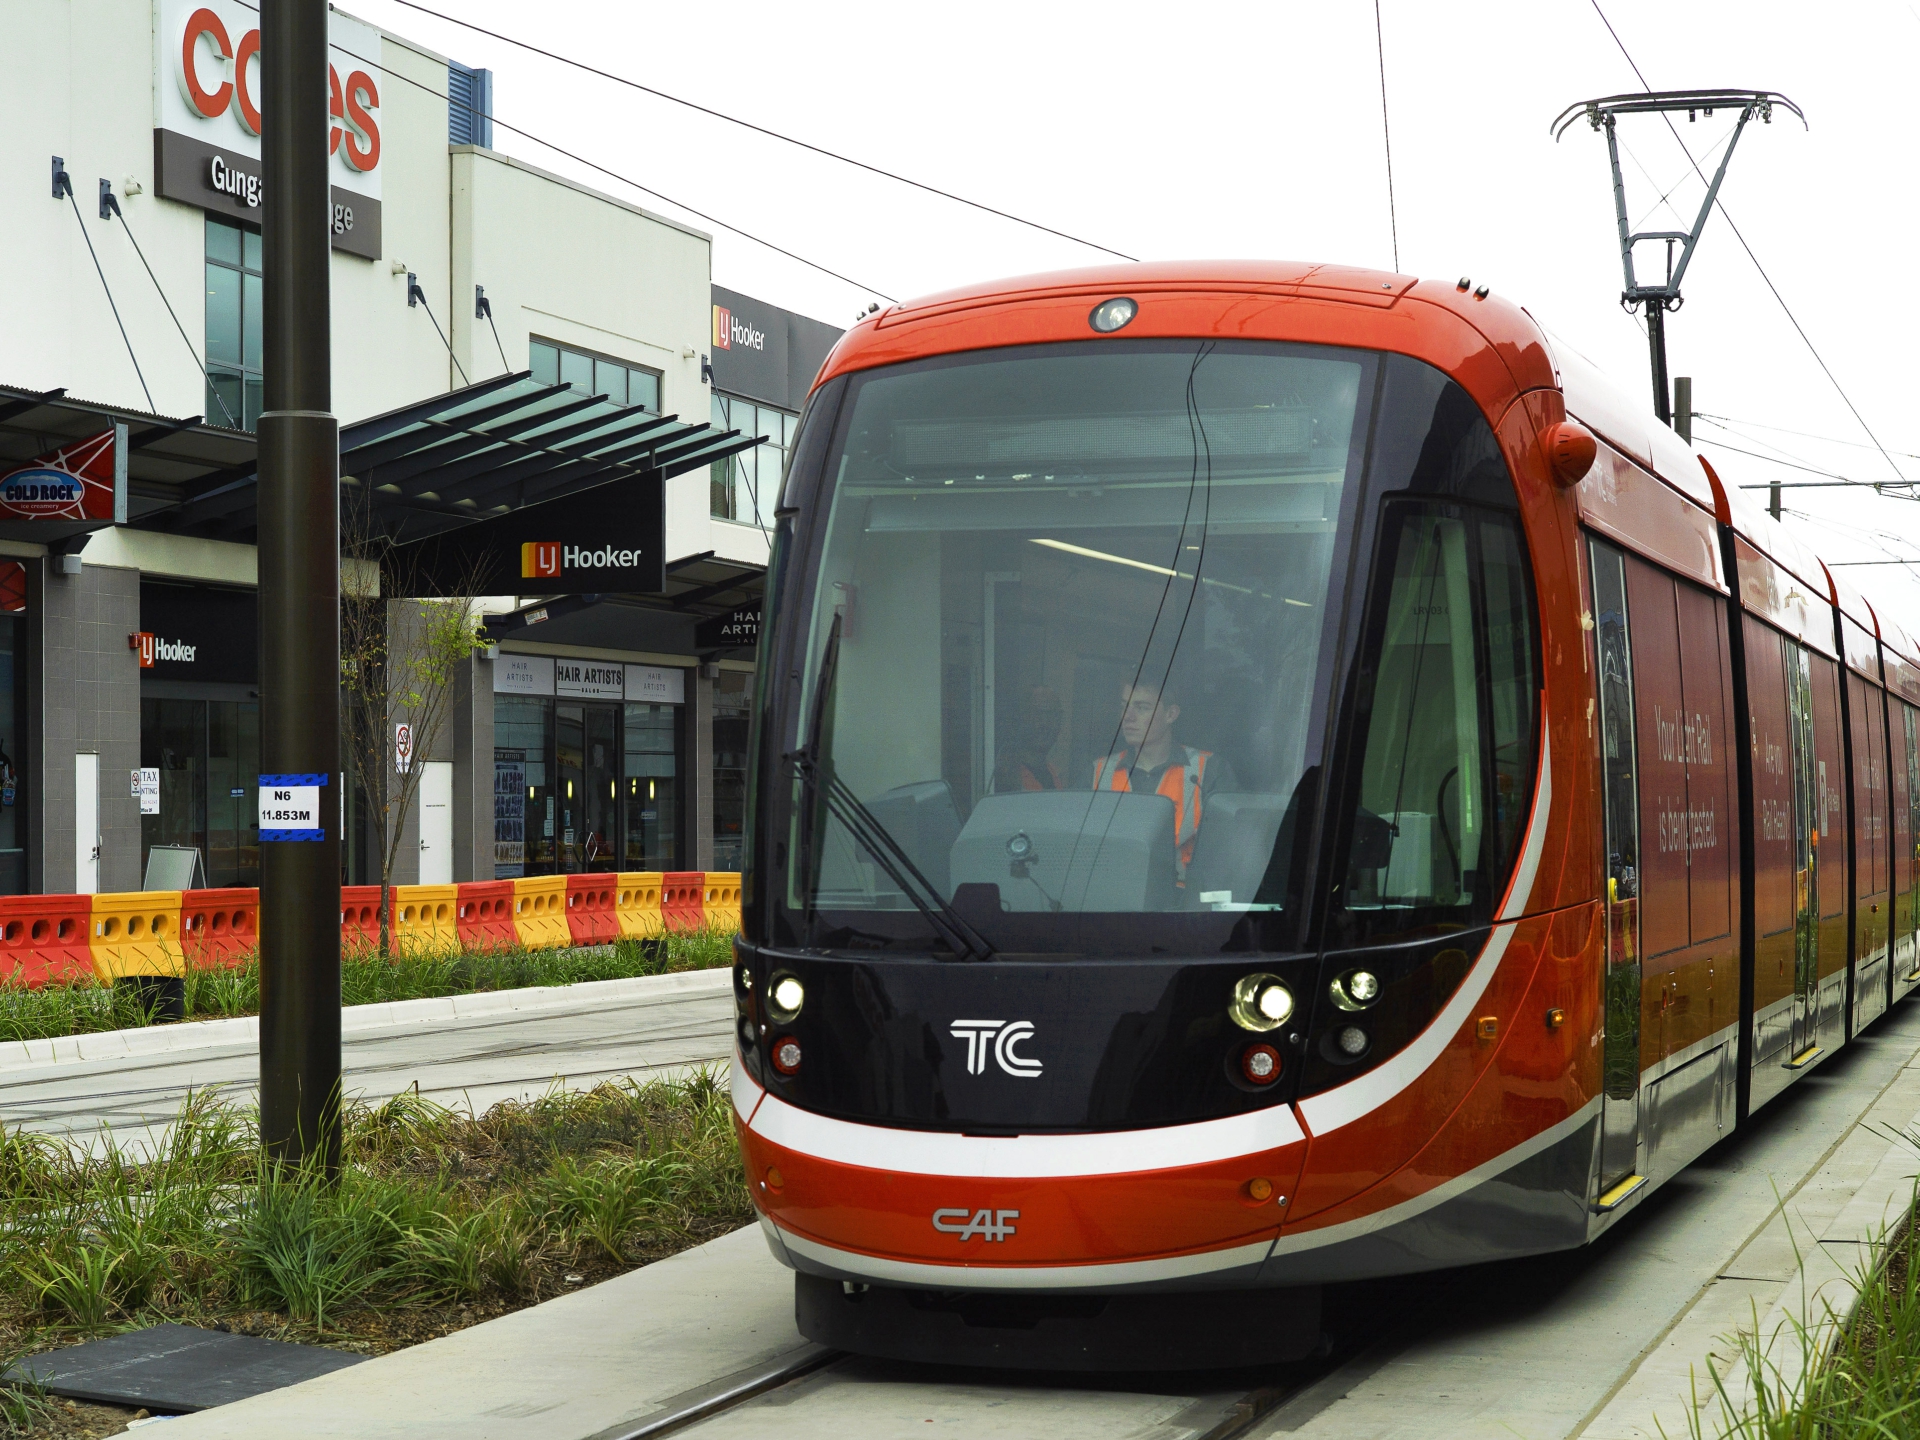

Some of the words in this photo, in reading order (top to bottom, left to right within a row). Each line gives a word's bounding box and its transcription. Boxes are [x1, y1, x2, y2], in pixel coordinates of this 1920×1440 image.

[720, 311, 729, 347] LJ
[730, 315, 765, 351] Hooker
[6, 484, 39, 501] COLD
[41, 484, 75, 501] ROCK
[539, 546, 556, 574] LJ
[563, 544, 642, 568] Hooker
[734, 611, 761, 622] HAI
[721, 624, 760, 635] ARTI
[142, 635, 153, 665] LJ
[154, 637, 197, 662] Hooker
[511, 661, 528, 671] HAIR
[506, 672, 534, 683] ARTISTS
[557, 665, 581, 684] HAIR
[583, 666, 622, 687] ARTISTS
[647, 672, 662, 681] HAIR
[643, 682, 667, 692] ARTISTS
[1654, 704, 1675, 762] Your
[1675, 709, 1697, 780] Light
[1697, 713, 1713, 766] Rail
[140, 787, 158, 795] NTING
[274, 791, 291, 801] N6
[261, 809, 311, 821] 11.853M
[1658, 795, 1667, 854] is
[1668, 795, 1691, 867] being
[1690, 796, 1717, 850] tested.
[950, 1019, 1044, 1078] TC
[932, 1208, 1020, 1242] CAF
